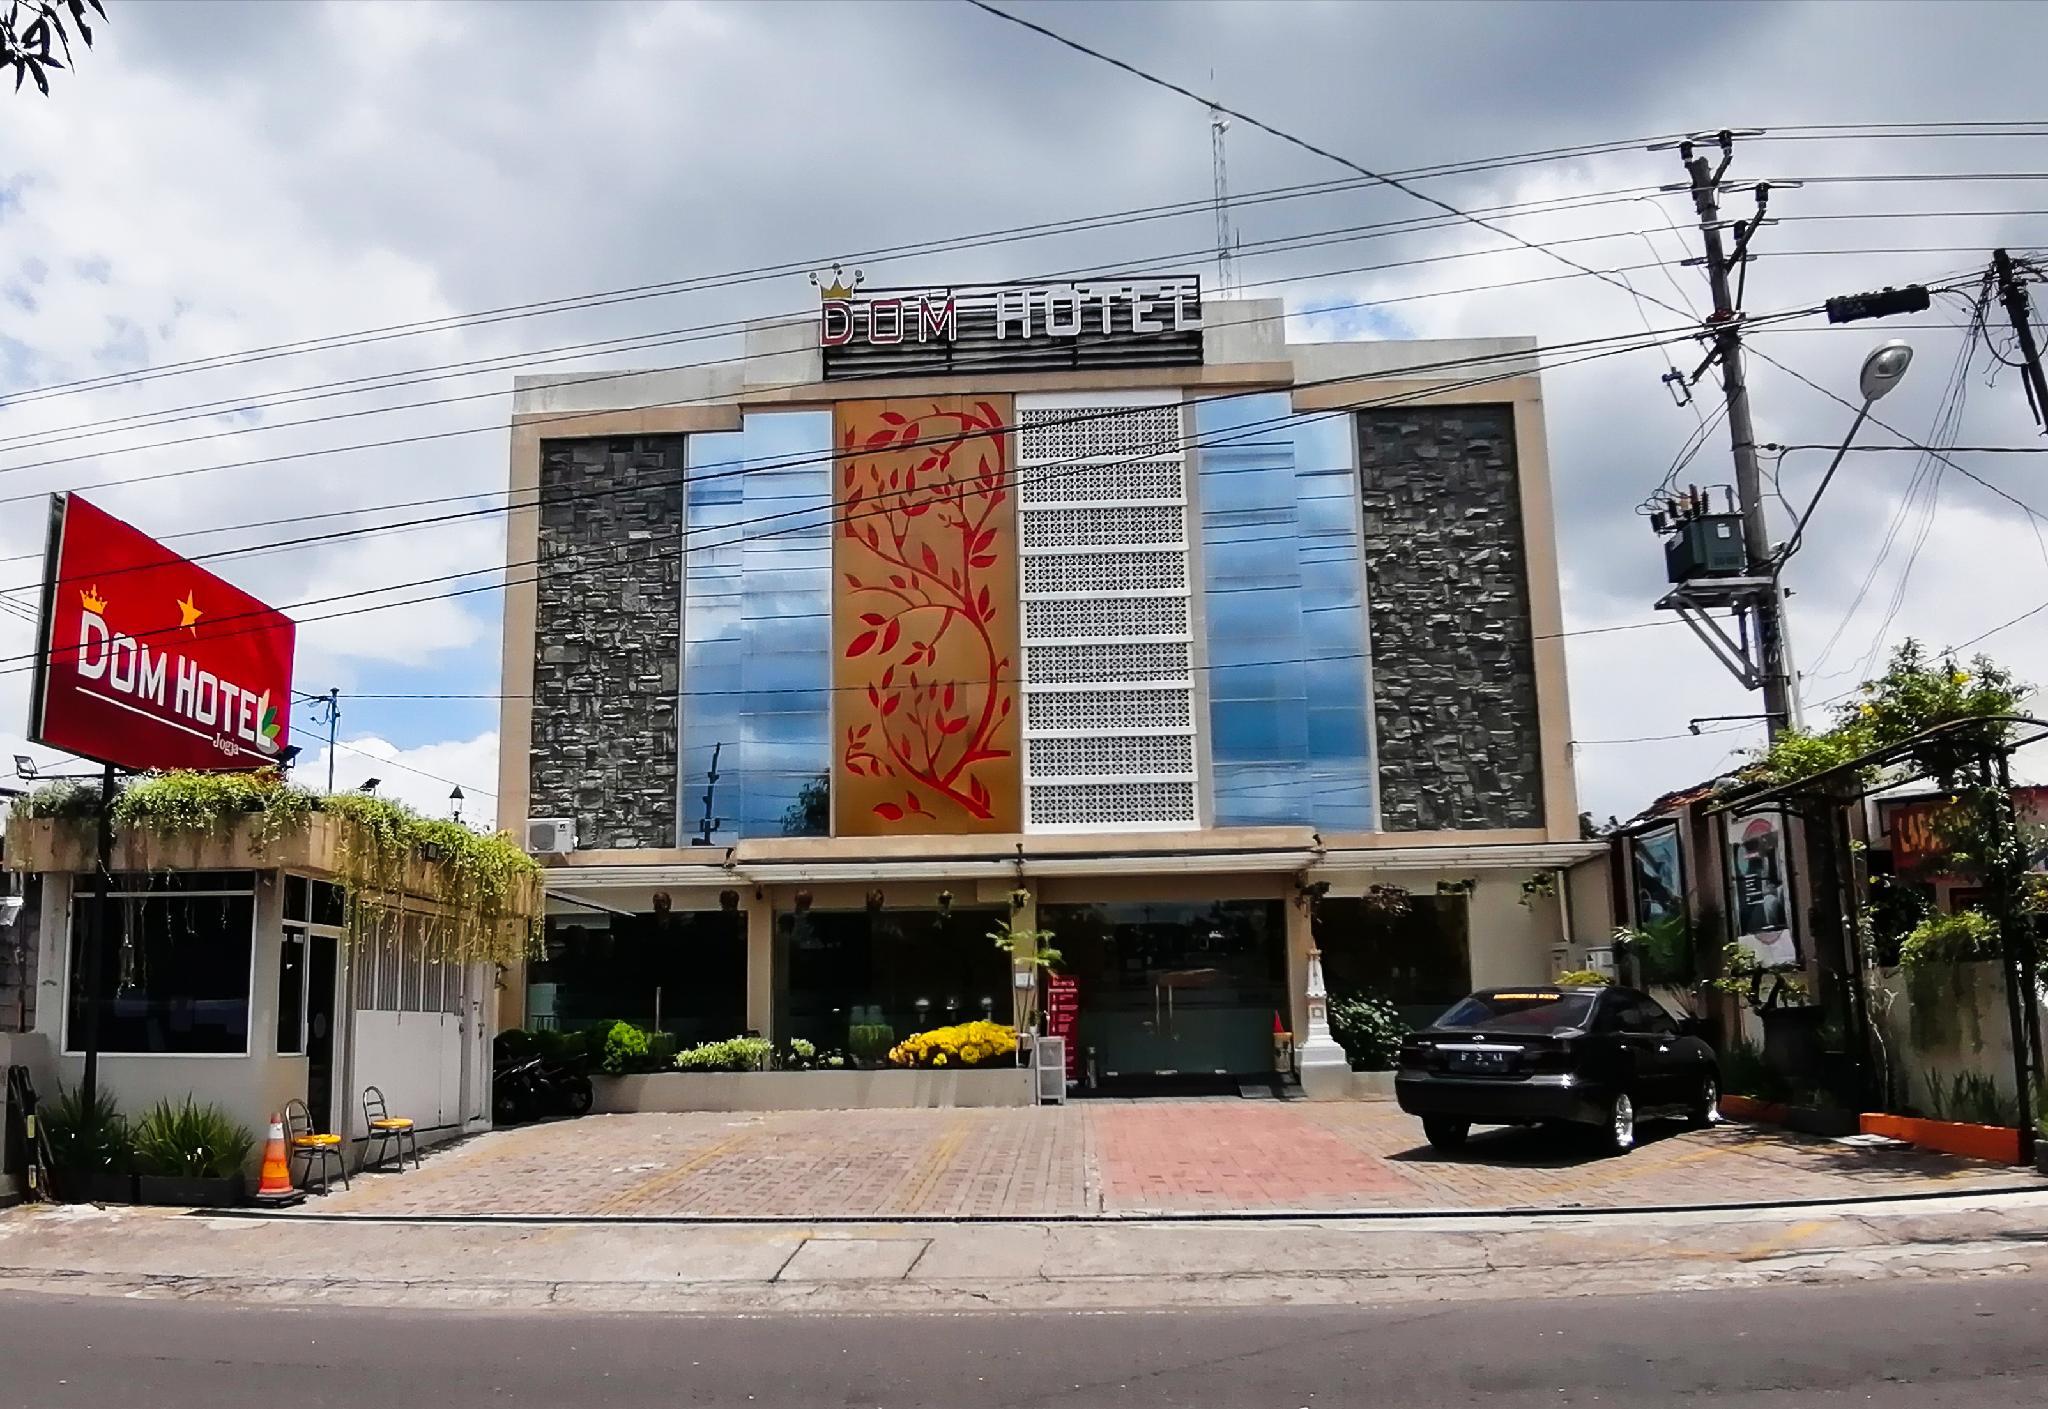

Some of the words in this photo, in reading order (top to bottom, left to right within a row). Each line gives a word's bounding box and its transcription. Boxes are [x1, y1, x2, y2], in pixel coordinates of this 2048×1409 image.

[819, 294, 958, 348] DOM
[995, 282, 1203, 341] HOTEL
[77, 610, 168, 706] DOM
[174, 654, 274, 747] HOTEL
[212, 733, 239, 756] Jogja
